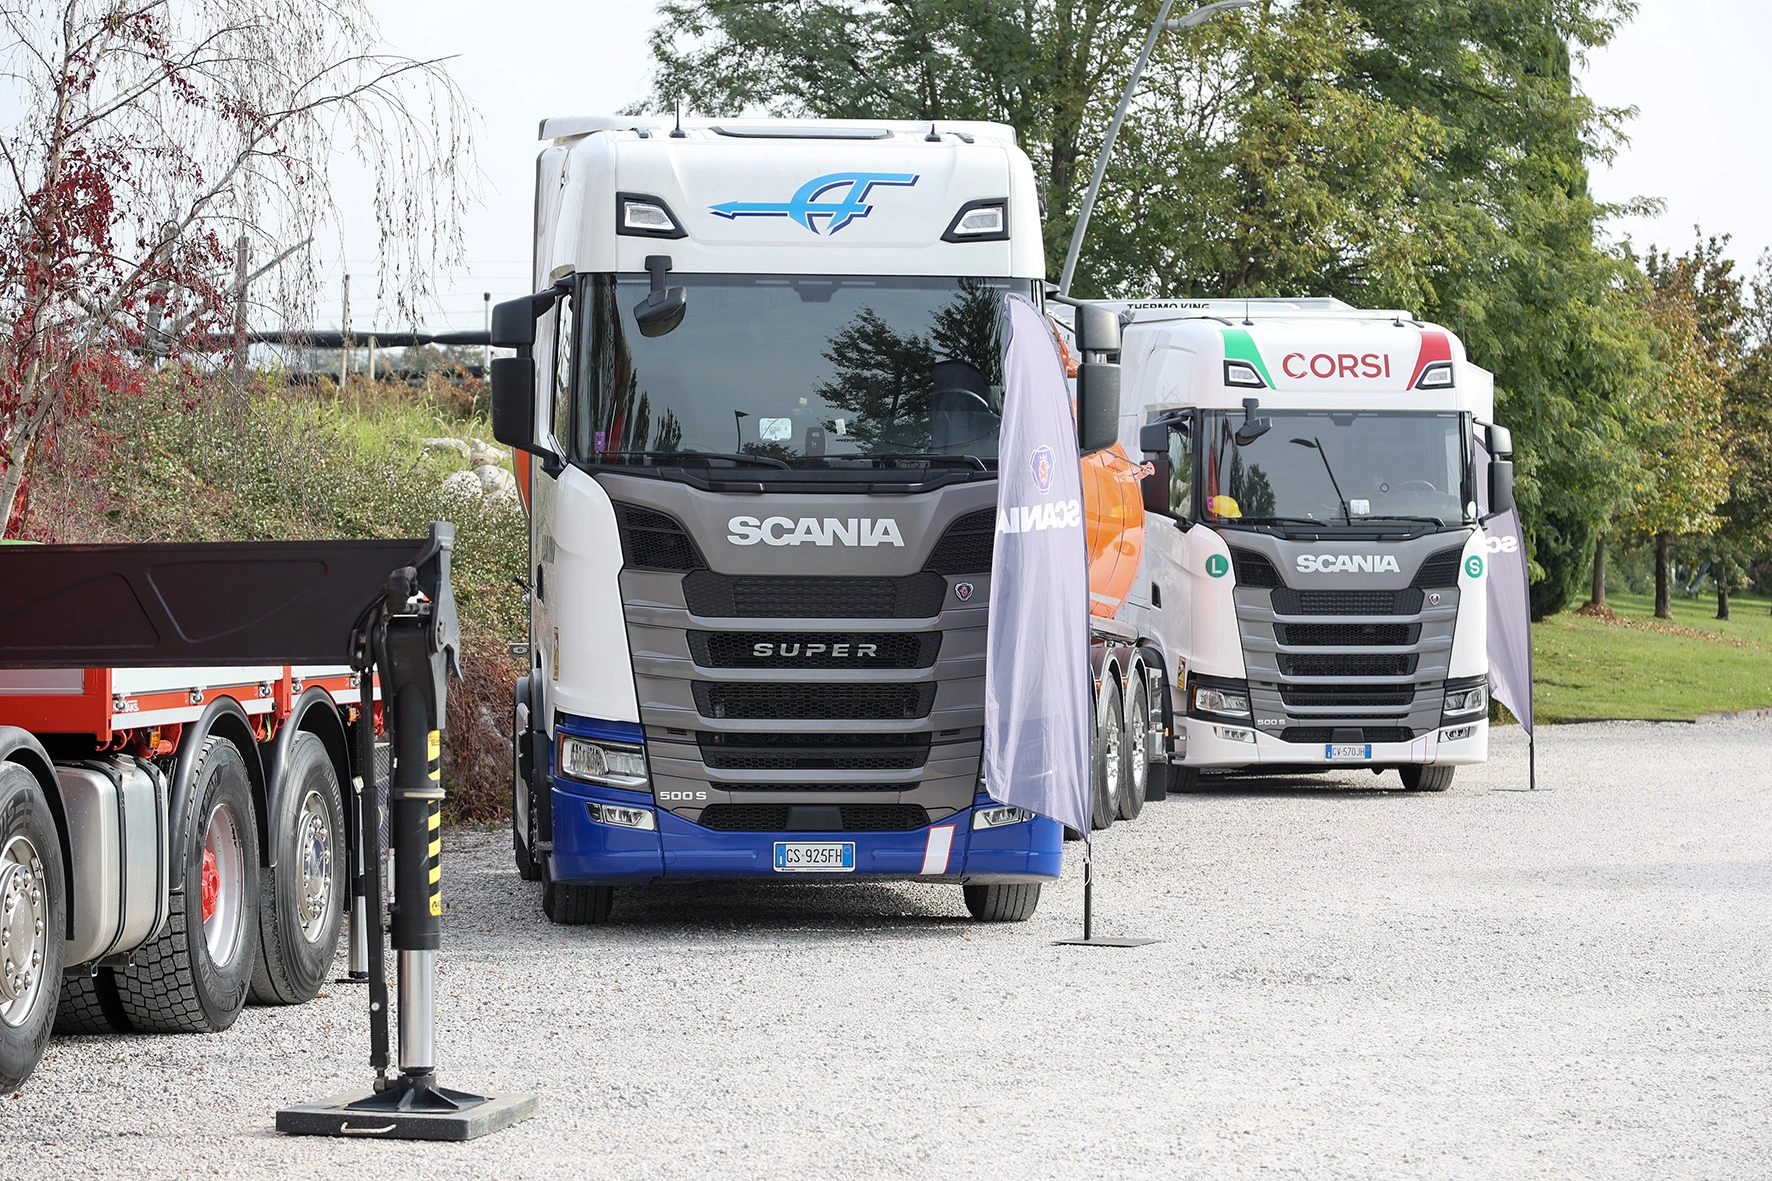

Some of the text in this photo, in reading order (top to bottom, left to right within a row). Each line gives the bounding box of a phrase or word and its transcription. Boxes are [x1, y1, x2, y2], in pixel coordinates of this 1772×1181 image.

[1282, 352, 1391, 379] CORSI
[726, 515, 905, 547] SCANIA
[1211, 558, 1222, 574] L
[1296, 554, 1401, 573] SCANIA
[1468, 558, 1481, 575] S
[752, 643, 878, 657] SUPER
[1257, 718, 1278, 726] 500
[659, 791, 707, 801] 500 S
[786, 848, 801, 863] GS
[805, 848, 843, 863] 925FH
